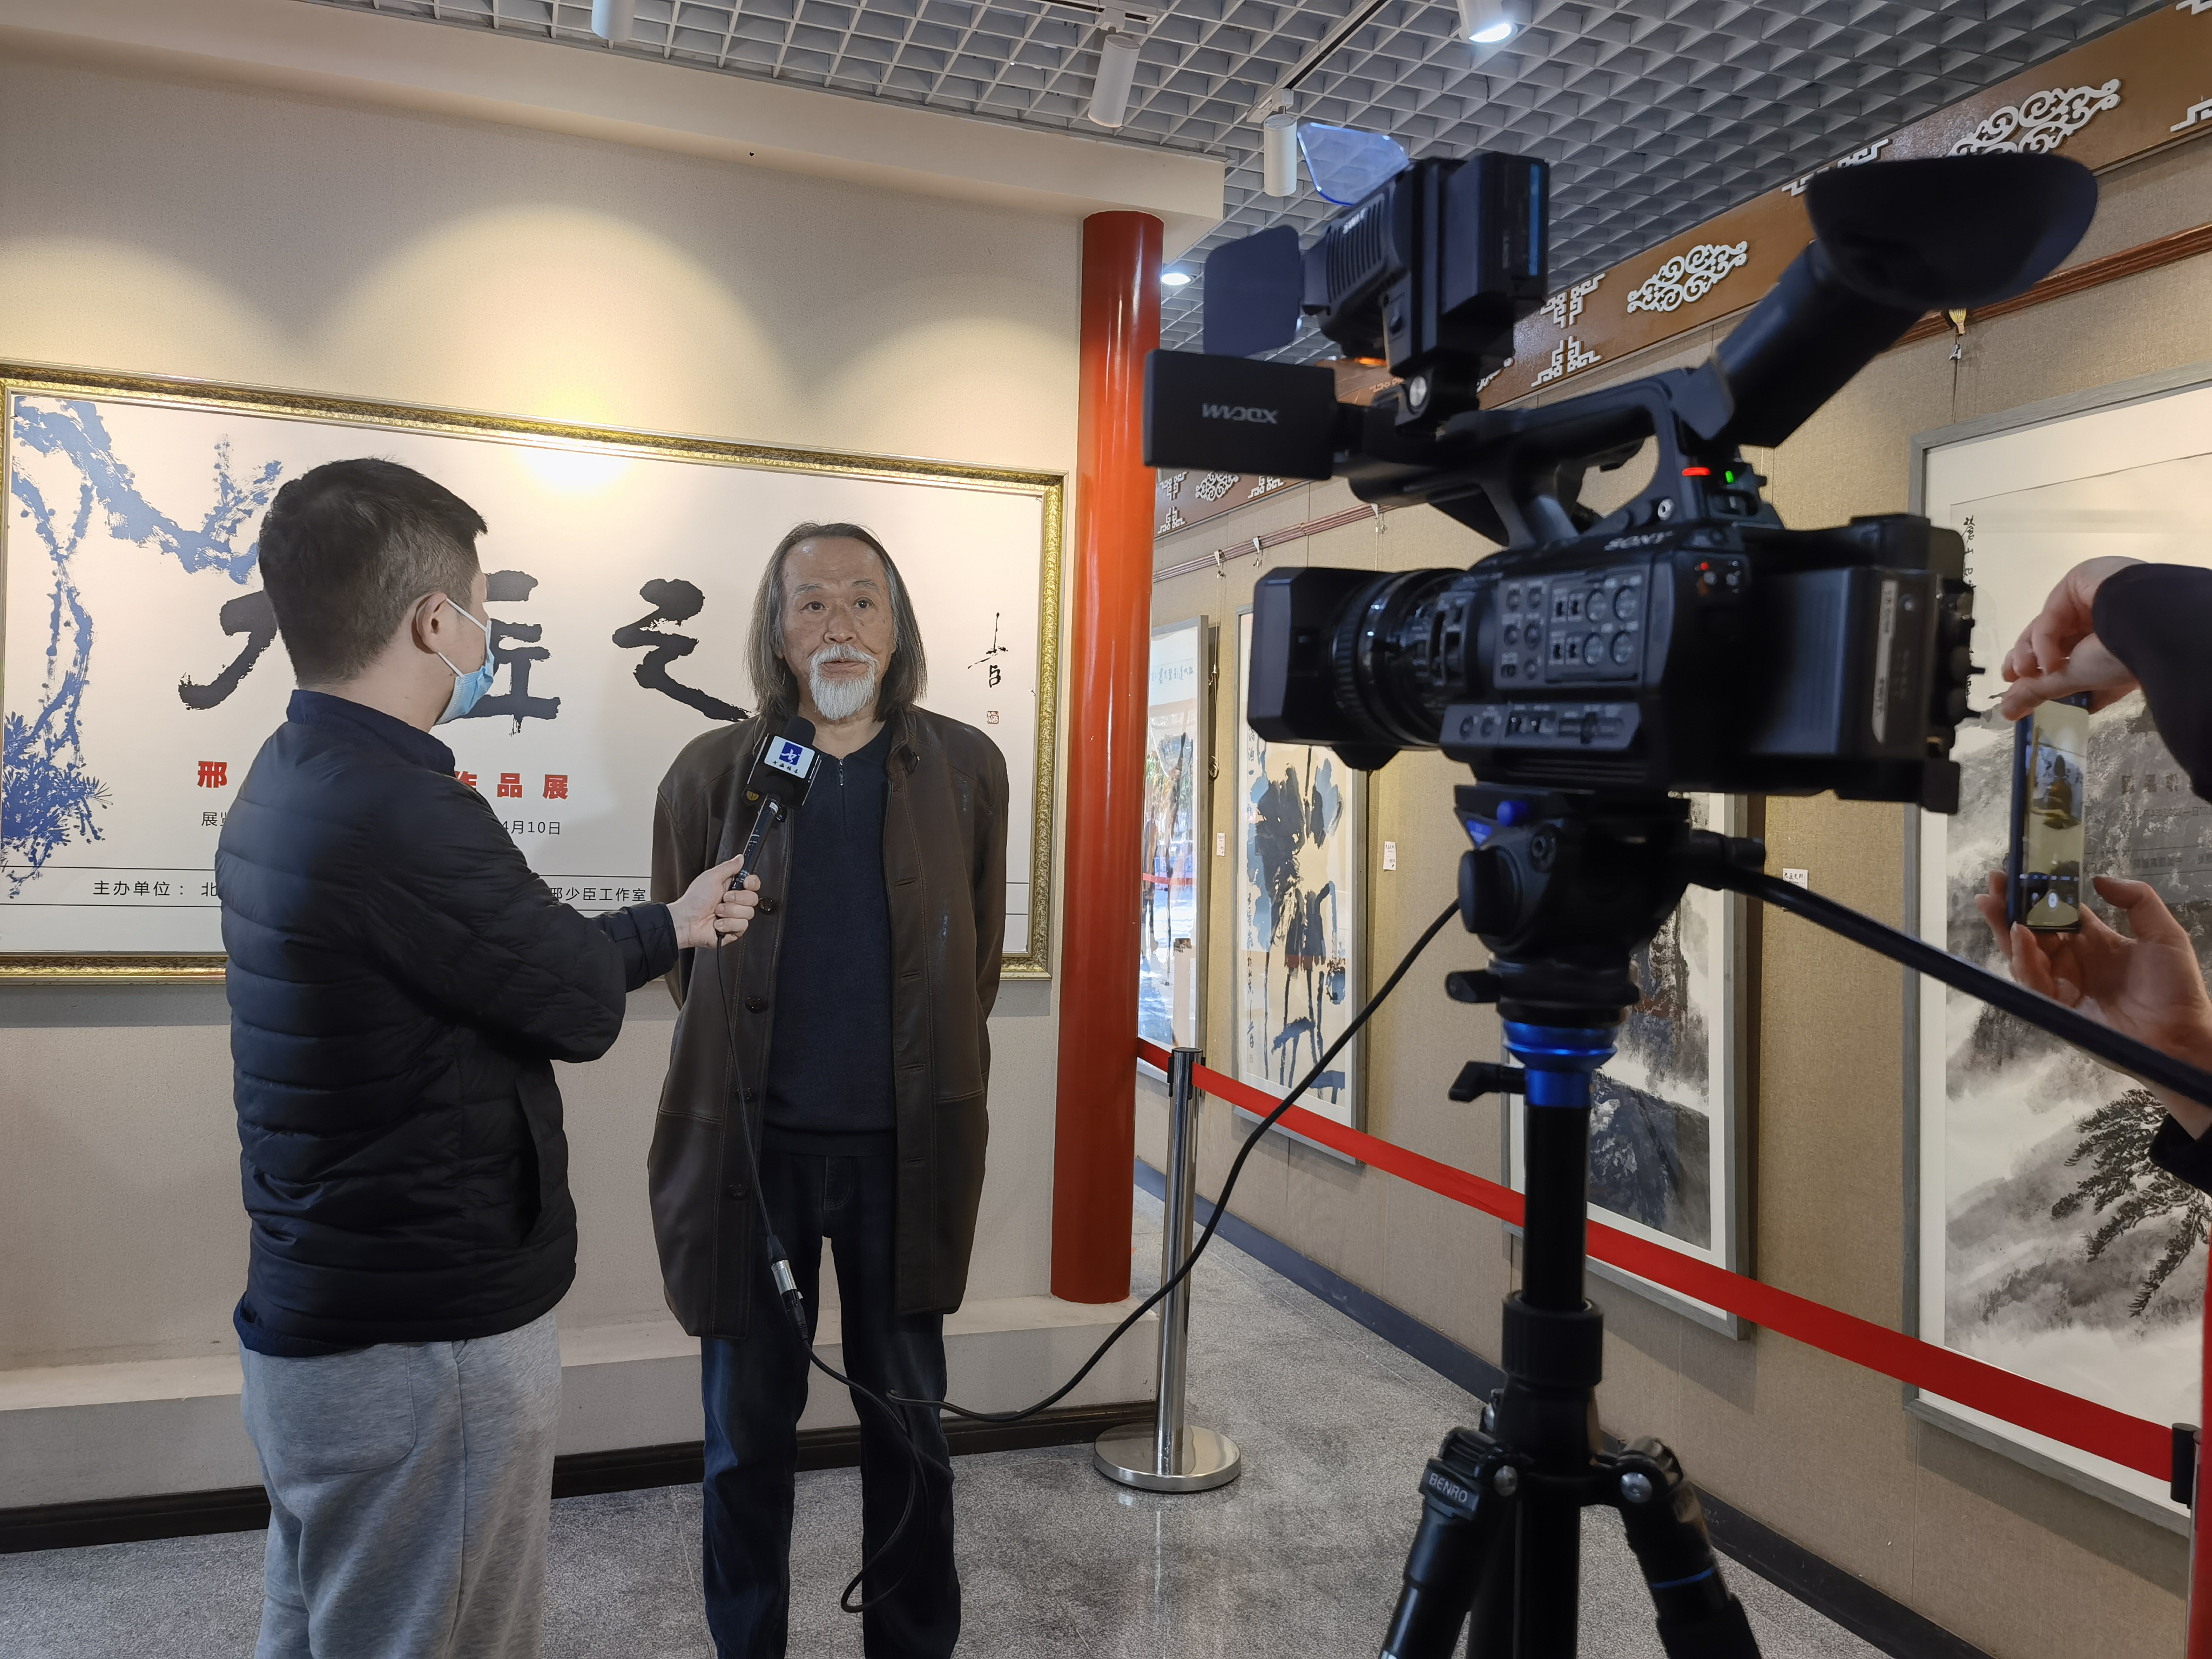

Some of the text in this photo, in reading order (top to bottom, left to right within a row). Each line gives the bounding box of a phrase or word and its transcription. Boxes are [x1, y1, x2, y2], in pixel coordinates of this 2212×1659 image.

[1202, 403, 1278, 424] XDCAM
[197, 761, 227, 788] 邢
[1429, 1473, 1468, 1502] BENRO
